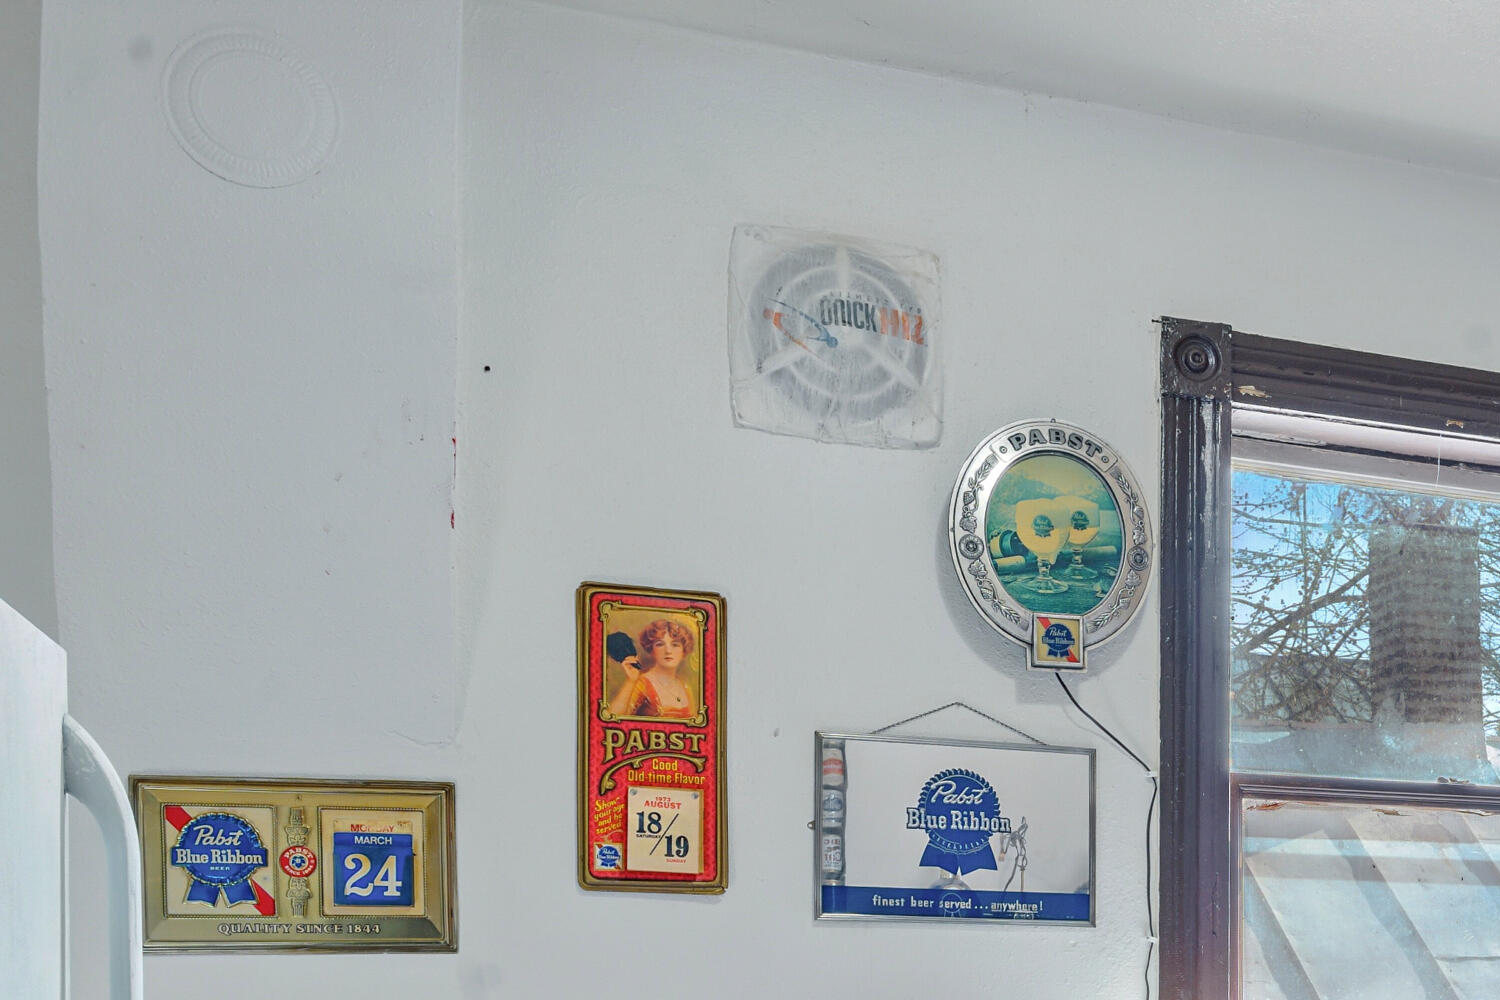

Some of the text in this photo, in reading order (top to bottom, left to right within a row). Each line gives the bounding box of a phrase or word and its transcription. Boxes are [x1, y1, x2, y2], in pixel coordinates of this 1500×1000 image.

[1008, 428, 1103, 458] PABST
[1049, 627, 1067, 637] Pabst
[601, 727, 706, 764] PABST
[652, 758, 678, 770] Good
[674, 773, 705, 784] Flavor
[931, 780, 988, 804] Pabst
[595, 797, 620, 812] Show
[644, 800, 681, 810] AUGUST
[636, 811, 661, 834] 18
[906, 807, 1011, 833] Blue Ribbon
[193, 824, 243, 845] Pabst
[350, 824, 394, 832] MOAY
[354, 836, 392, 845] MARCH
[664, 834, 689, 858] 19
[176, 849, 263, 864] Blue Ribbon
[344, 853, 402, 896] 24
[872, 895, 905, 906] finest
[911, 896, 934, 908] beer
[217, 923, 381, 935] QUALITY SINCE 1844
